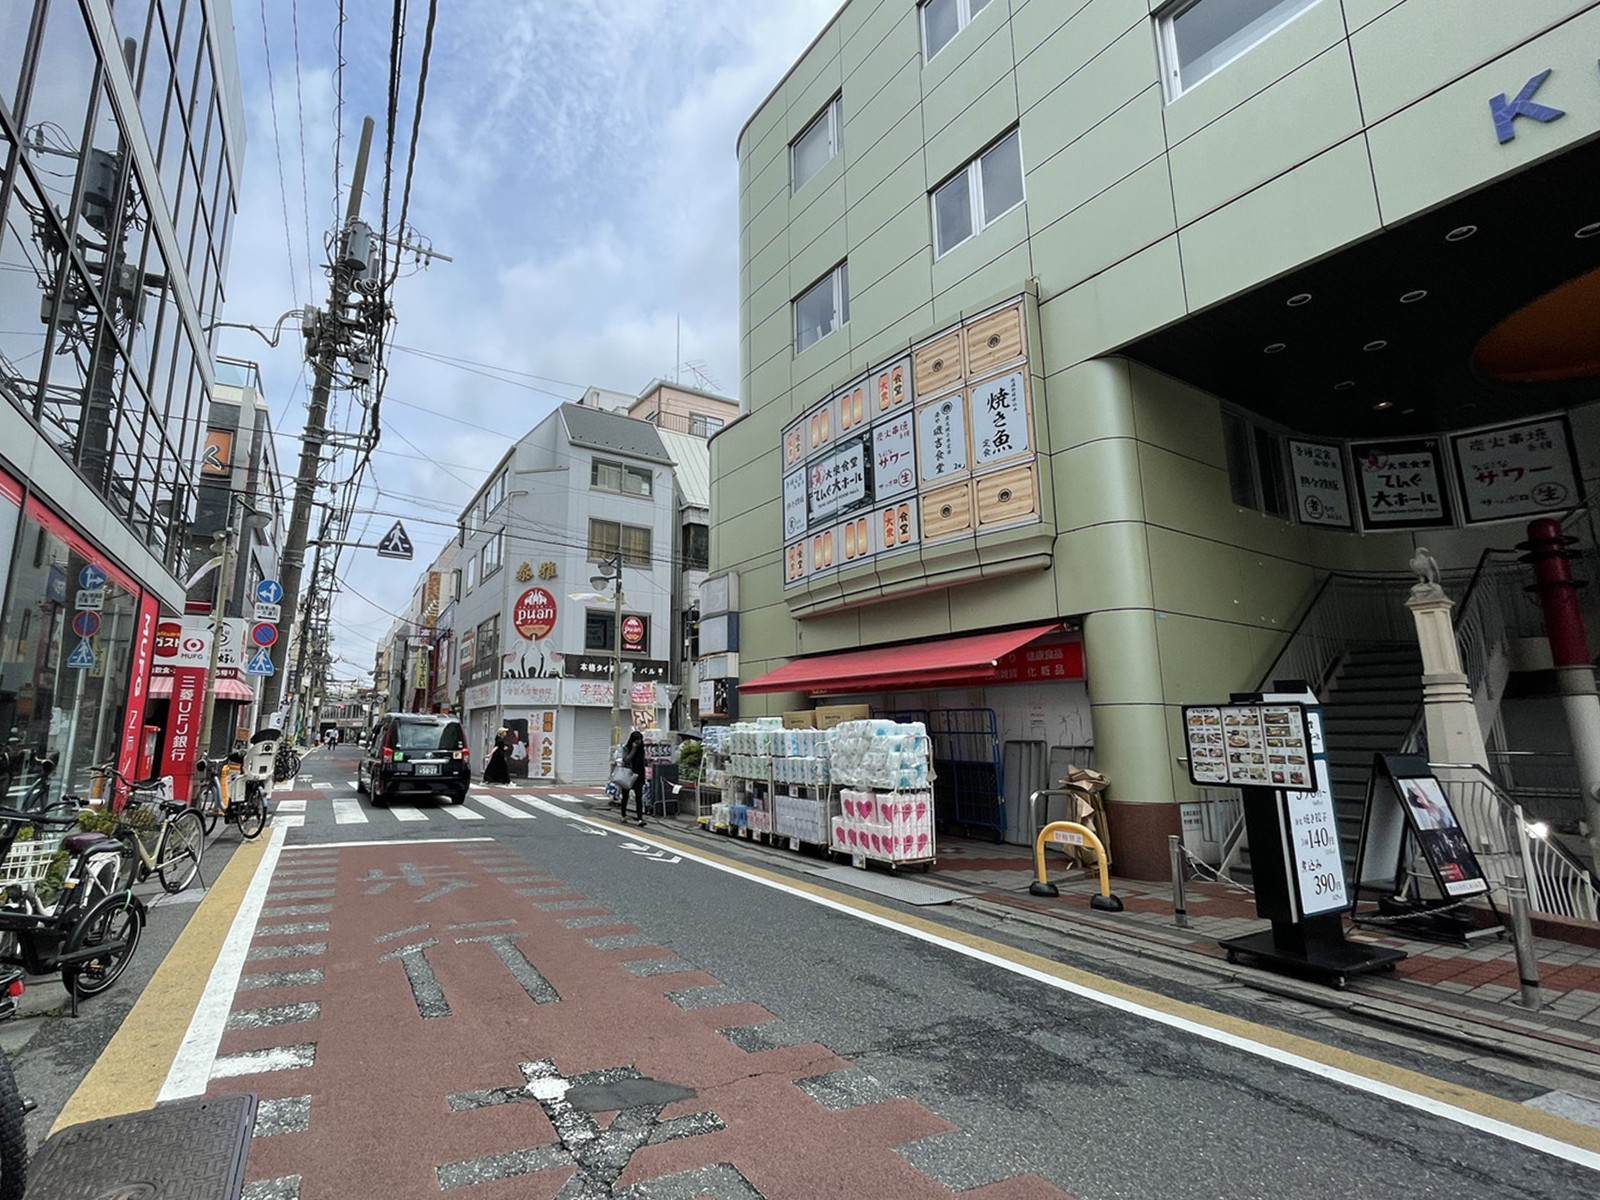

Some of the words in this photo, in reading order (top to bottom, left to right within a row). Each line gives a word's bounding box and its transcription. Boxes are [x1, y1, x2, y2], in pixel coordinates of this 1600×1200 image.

[1489, 60, 1600, 144] K
[987, 387, 1013, 454] 焼き魚
[879, 450, 910, 470] サワー
[1387, 460, 1432, 471] 大衆食堂
[1377, 473, 1422, 488] てんぐ
[1475, 466, 1553, 486] サワー
[813, 472, 863, 502] てんぐ大ホール
[1537, 484, 1561, 501] 生
[1371, 490, 1437, 509] 大ホール
[885, 517, 895, 539] 大衆
[899, 511, 909, 536] 食堂
[516, 606, 554, 625] puan
[1027, 663, 1065, 678] 化粧品
[579, 683, 614, 697] 学芸大
[171, 675, 196, 762] 三菱UFJ銀行
